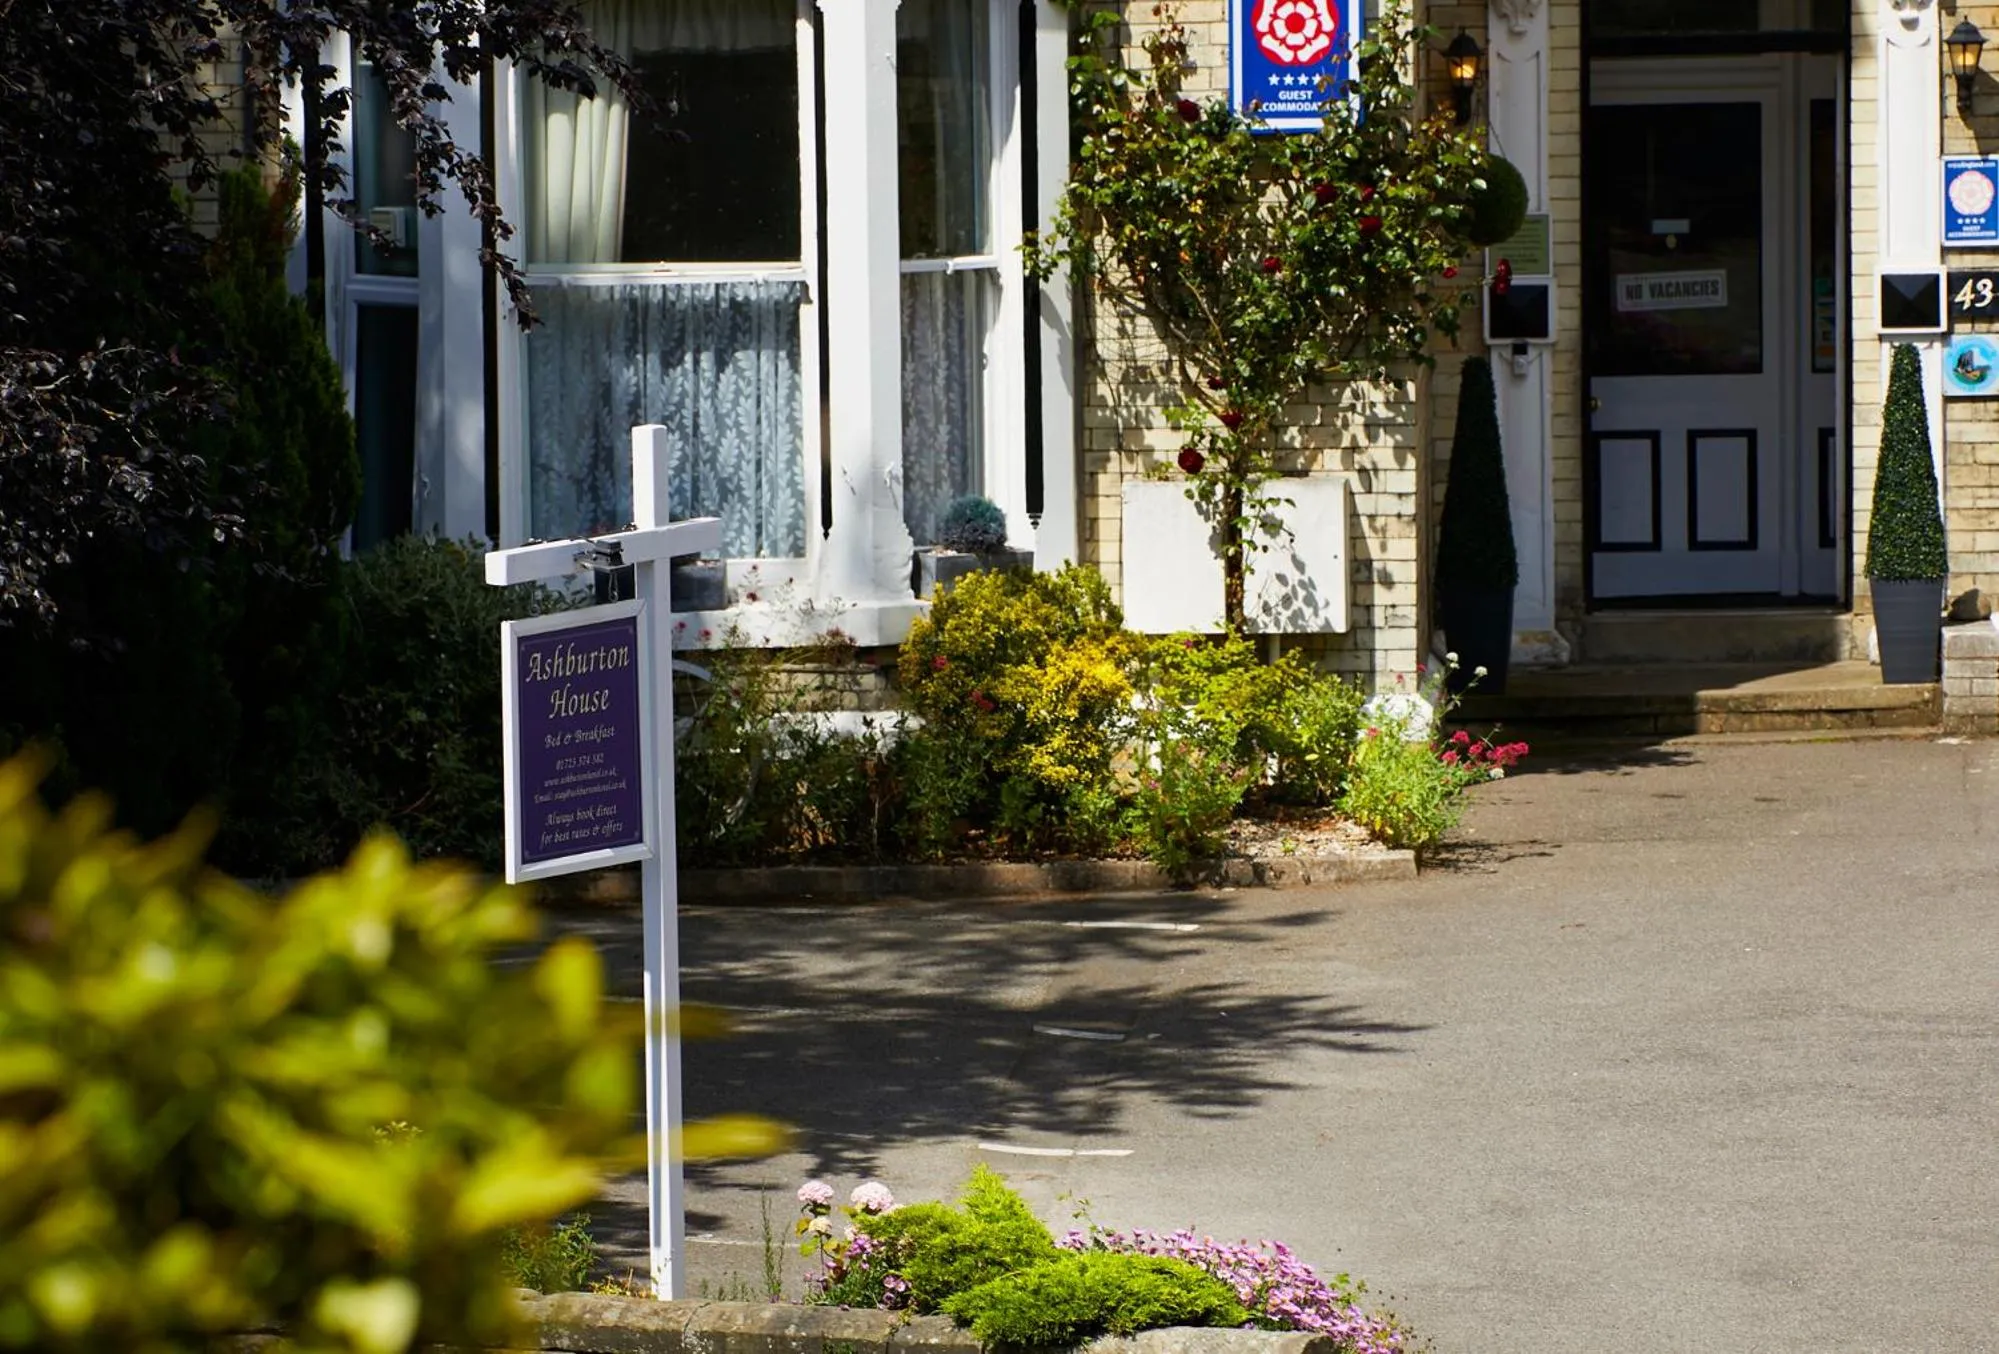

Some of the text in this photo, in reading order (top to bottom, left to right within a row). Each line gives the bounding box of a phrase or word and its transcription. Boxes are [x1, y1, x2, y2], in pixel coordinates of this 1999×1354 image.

[1278, 89, 1314, 100] GUEST
[1625, 279, 1720, 300] NO VACANCIES
[1954, 279, 1993, 310] 43
[525, 642, 630, 683] Ashburton
[549, 683, 610, 719] House
[544, 731, 562, 749] Bed
[574, 723, 615, 743] Breakfast
[575, 804, 595, 821] book
[595, 803, 617, 818] direct
[539, 831, 553, 851] for
[554, 829, 570, 843] best
[601, 820, 624, 838] offers
